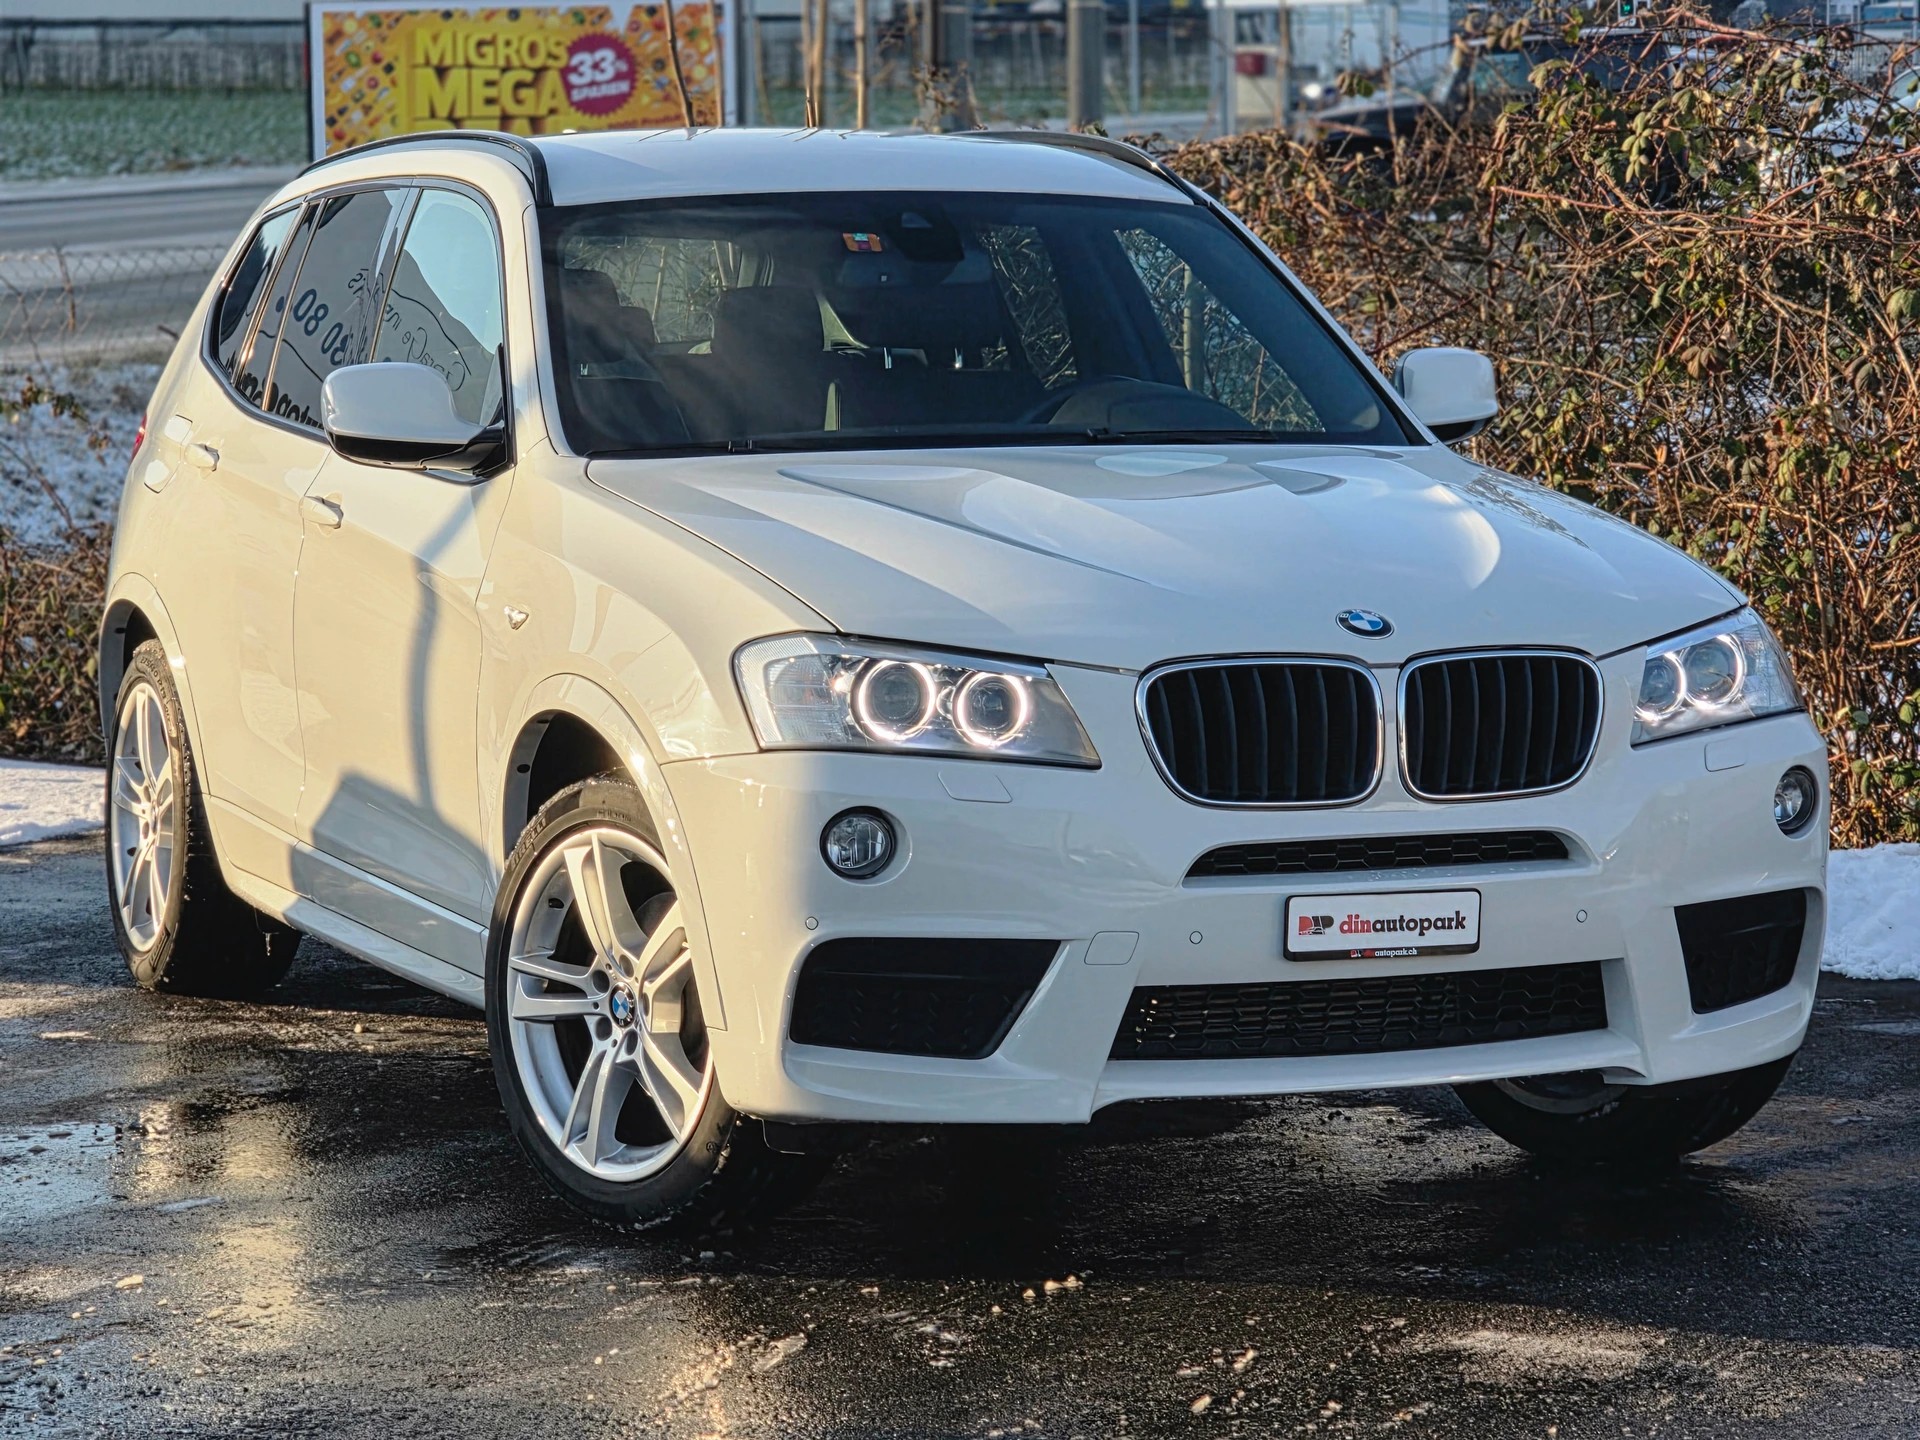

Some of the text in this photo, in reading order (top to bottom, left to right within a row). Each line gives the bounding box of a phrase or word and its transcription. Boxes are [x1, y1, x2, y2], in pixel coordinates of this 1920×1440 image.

[415, 28, 569, 69] MIGROS
[415, 66, 571, 118] MEGA
[1339, 910, 1467, 937] dinautopark
